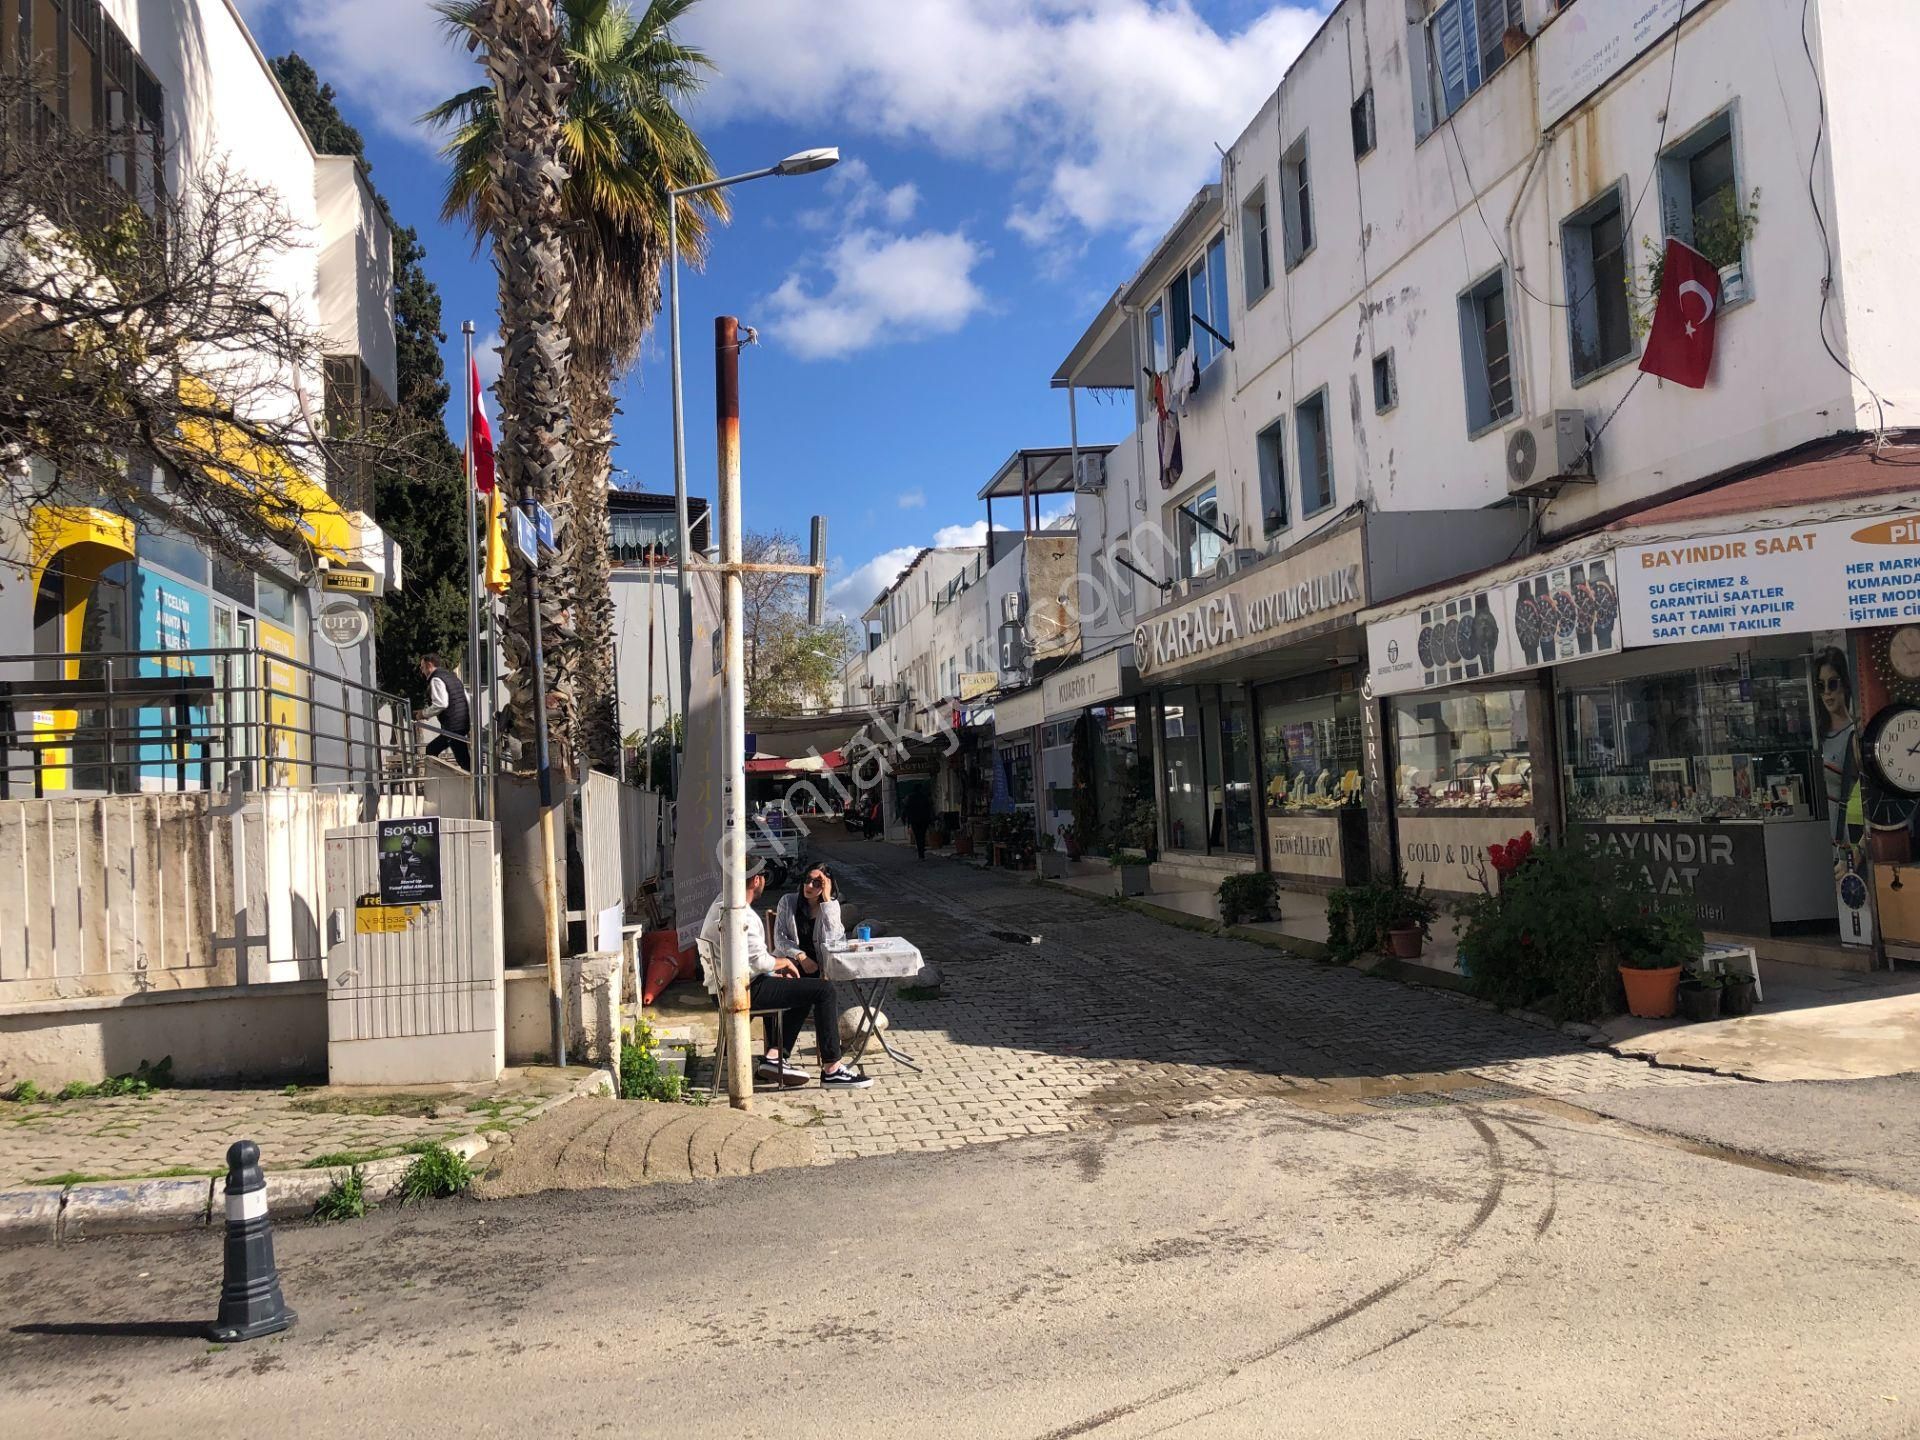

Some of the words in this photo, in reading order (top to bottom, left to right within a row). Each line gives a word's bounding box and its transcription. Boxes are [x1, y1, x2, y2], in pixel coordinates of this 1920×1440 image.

[1641, 542, 1747, 570] BAYINDIR
[1754, 533, 1817, 556] SAAT
[1846, 562, 1874, 575] HER
[1648, 584, 1665, 596] SU
[1669, 576, 1735, 594] GEÇİRMEZ
[1740, 575, 1750, 586] &
[1650, 592, 1719, 611] GARANTİLİ
[1723, 587, 1784, 602] SAATLER
[1848, 594, 1877, 606] HER
[323, 616, 359, 629] UPT
[1153, 592, 1244, 666] KARACA
[1246, 564, 1360, 636] KUYUMCULUK
[1651, 612, 1685, 624] SAAT
[1690, 606, 1737, 620] TAMİRİ
[1741, 601, 1795, 615] YAPILIR
[1849, 606, 1899, 622] İŞİTME
[1652, 627, 1685, 639] SAAT
[1691, 623, 1725, 636] CAMI
[1730, 618, 1782, 632] TAKILIR
[1058, 676, 1086, 703] KUAFÖR
[1088, 673, 1096, 695] 17
[1897, 722, 1906, 733] 11
[1908, 719, 1918, 730] 12
[1888, 732, 1899, 742] 10
[384, 821, 434, 837] social
[1274, 835, 1334, 858] JEWELLERY
[1407, 842, 1441, 863] GOLD
[1446, 844, 1455, 864] &
